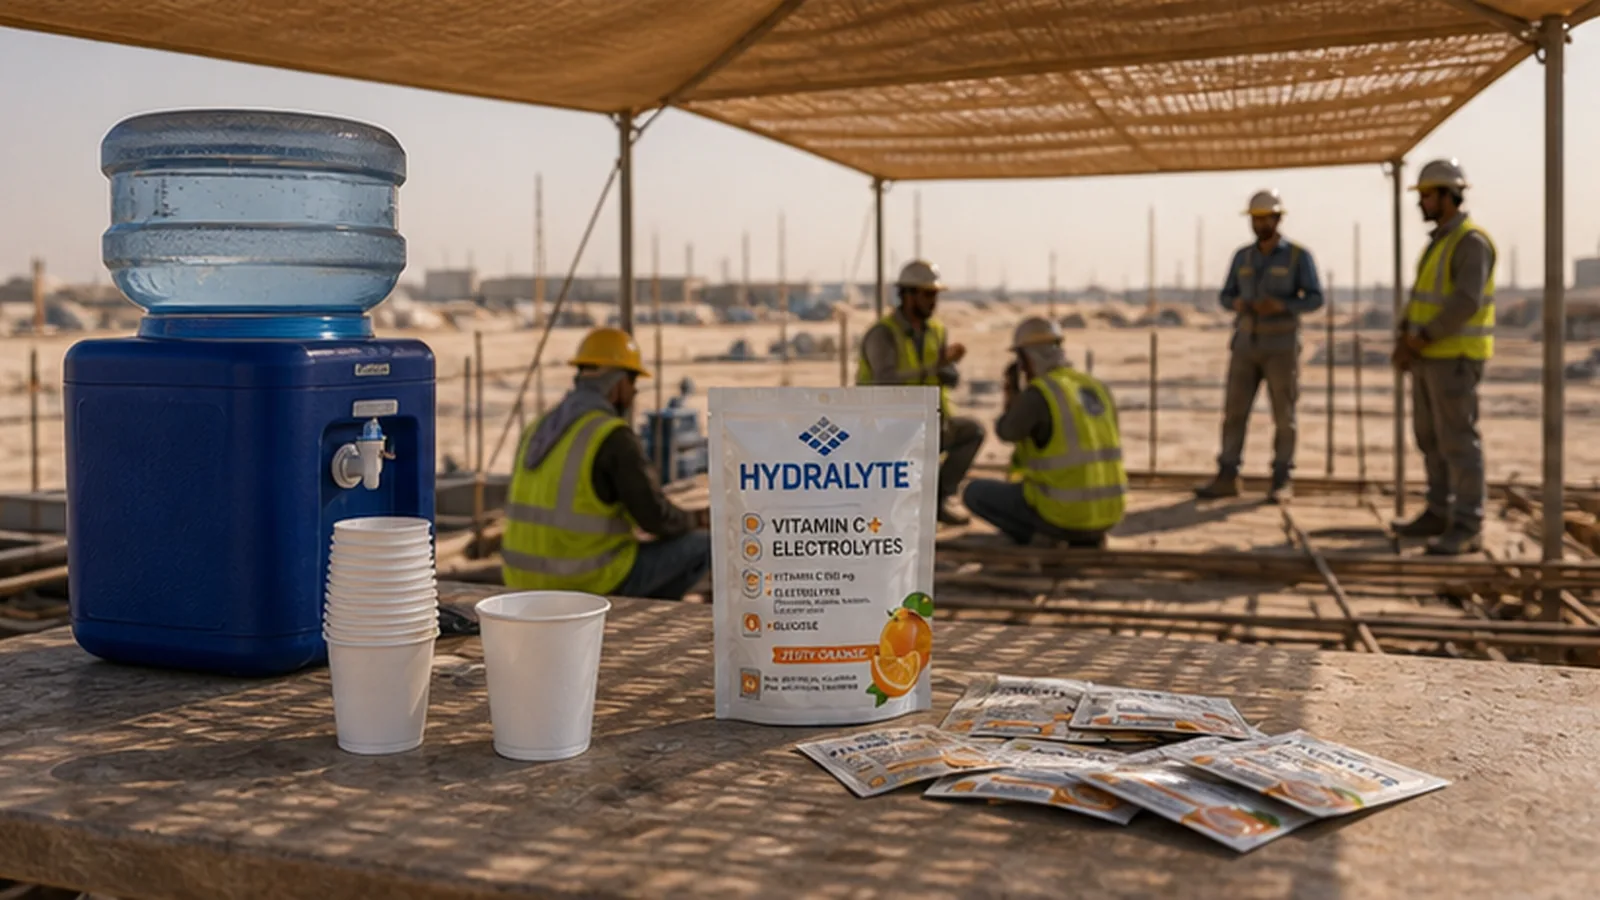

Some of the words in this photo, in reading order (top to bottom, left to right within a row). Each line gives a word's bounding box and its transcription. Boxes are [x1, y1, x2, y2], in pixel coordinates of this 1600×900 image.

[739, 461, 910, 490] HYDRALYTE
[772, 517, 849, 534] VITAMIN
[772, 538, 903, 557] ELECTROLYTES
